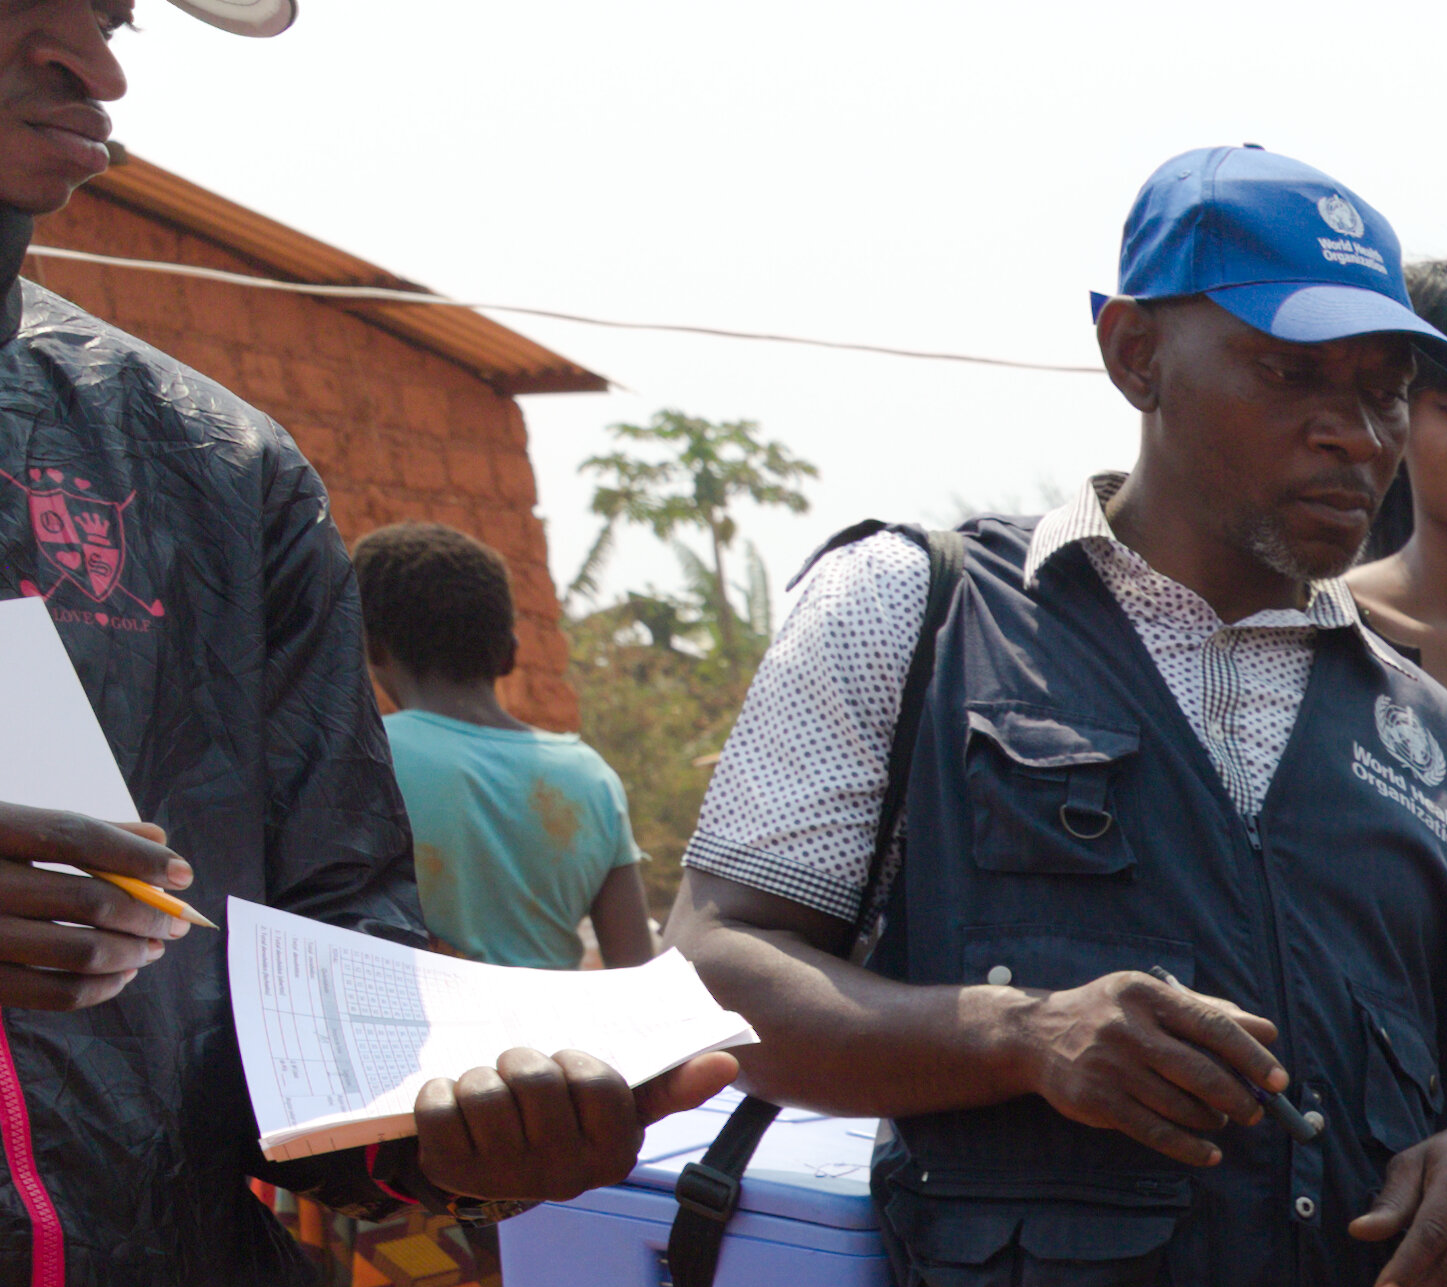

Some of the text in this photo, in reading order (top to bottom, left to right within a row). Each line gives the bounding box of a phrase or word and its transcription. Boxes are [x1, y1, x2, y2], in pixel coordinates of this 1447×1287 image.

[1317, 237, 1354, 252] World
[1322, 249, 1389, 275] Organization
[52, 607, 151, 633] LOVE GOLF
[1353, 740, 1407, 791] World
